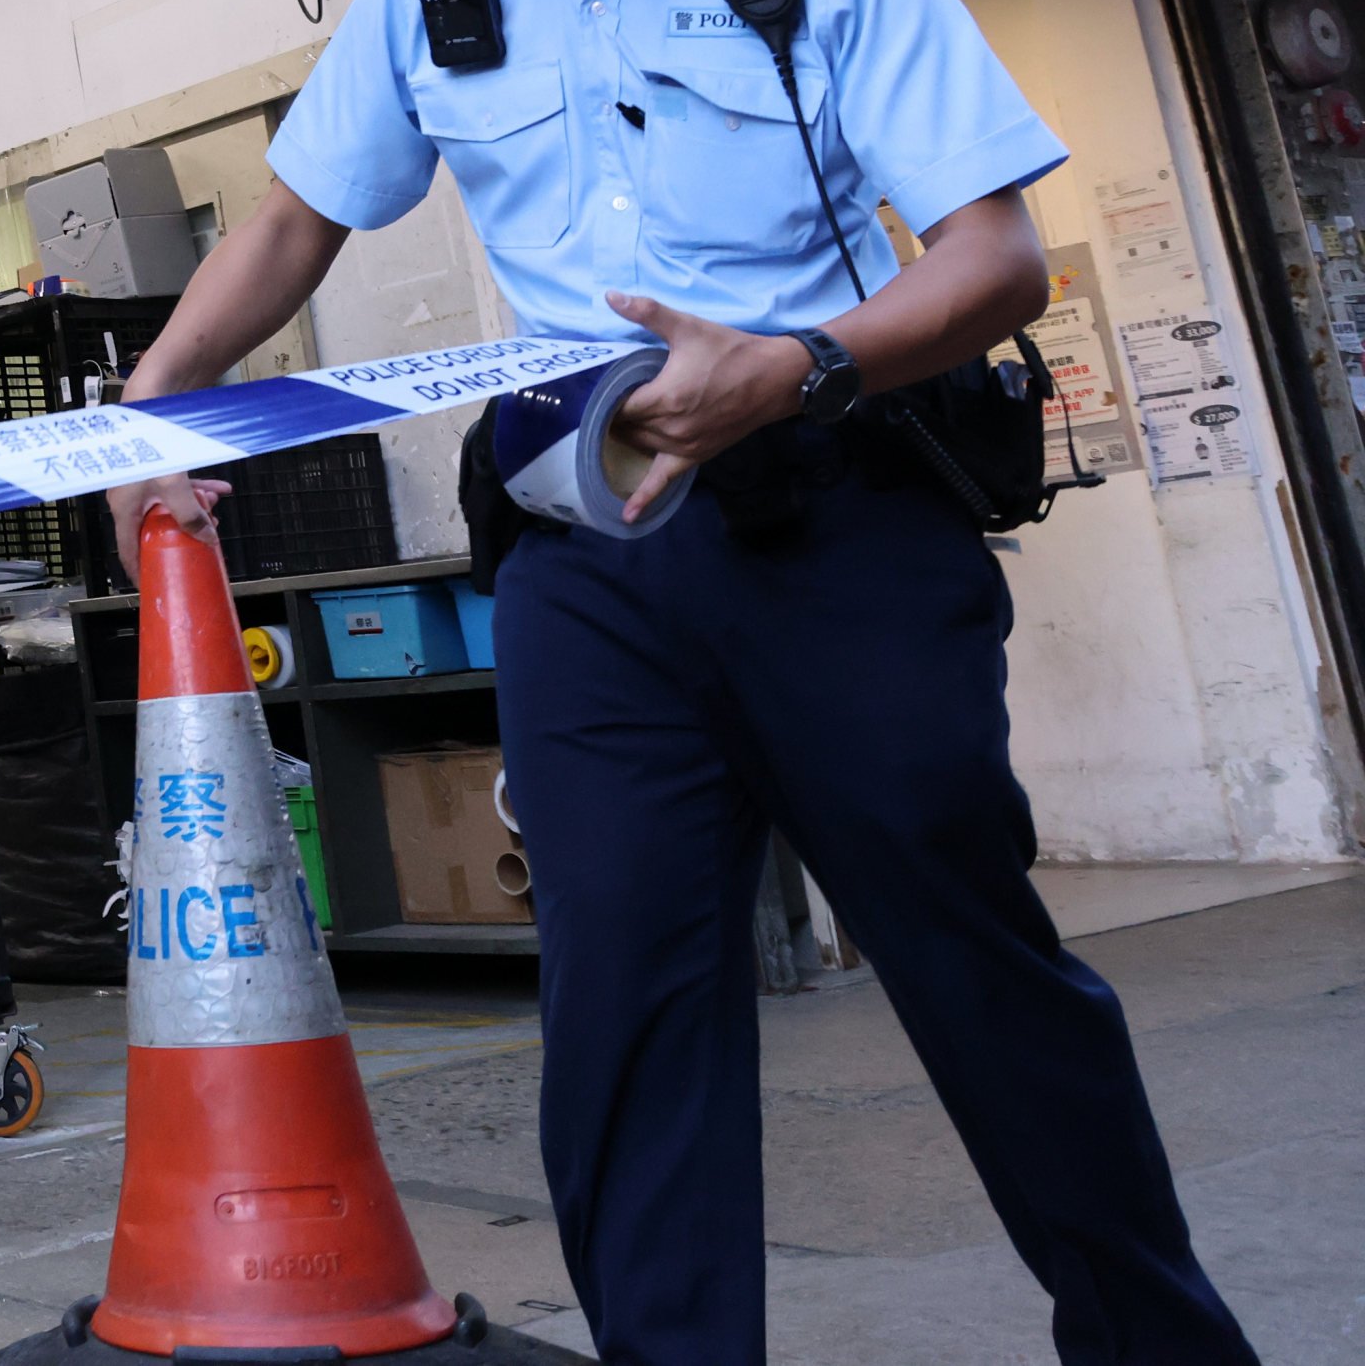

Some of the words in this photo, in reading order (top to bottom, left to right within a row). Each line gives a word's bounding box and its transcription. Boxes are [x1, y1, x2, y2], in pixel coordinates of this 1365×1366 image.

[675, 11, 694, 31] 警
[331, 352, 424, 387] POLICE
[415, 375, 456, 401] DO
[456, 366, 504, 393] NOT
[521, 344, 614, 380] CROSS
[38, 439, 164, 484] 不得越過
[243, 1251, 341, 1282] BIGFOOT
